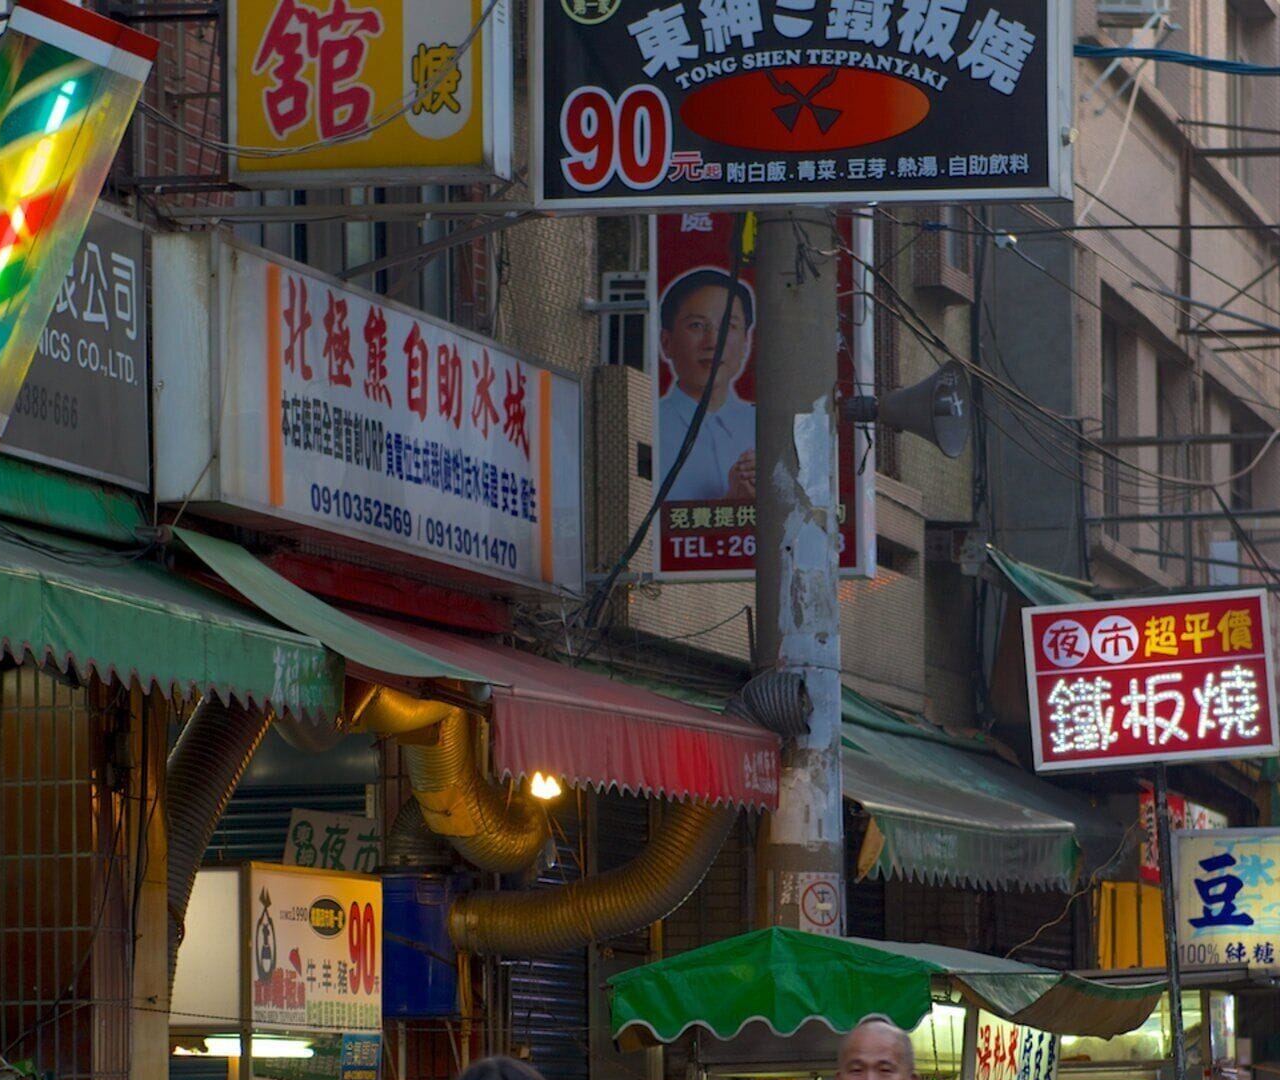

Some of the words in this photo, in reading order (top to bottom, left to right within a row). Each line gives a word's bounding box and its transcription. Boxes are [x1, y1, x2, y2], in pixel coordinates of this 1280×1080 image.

[675, 55, 738, 91] TONG
[742, 49, 799, 69] SHEN
[805, 48, 950, 92] TEPPANYAKI
[561, 84, 671, 191] 90
[283, 275, 530, 462] 北極熊自助冰城
[311, 484, 413, 537] 0910352569
[426, 518, 517, 569] 0913011470
[1144, 609, 1253, 657] 超平價
[1047, 664, 1261, 754] 鐵板燒
[349, 901, 375, 996] 90
